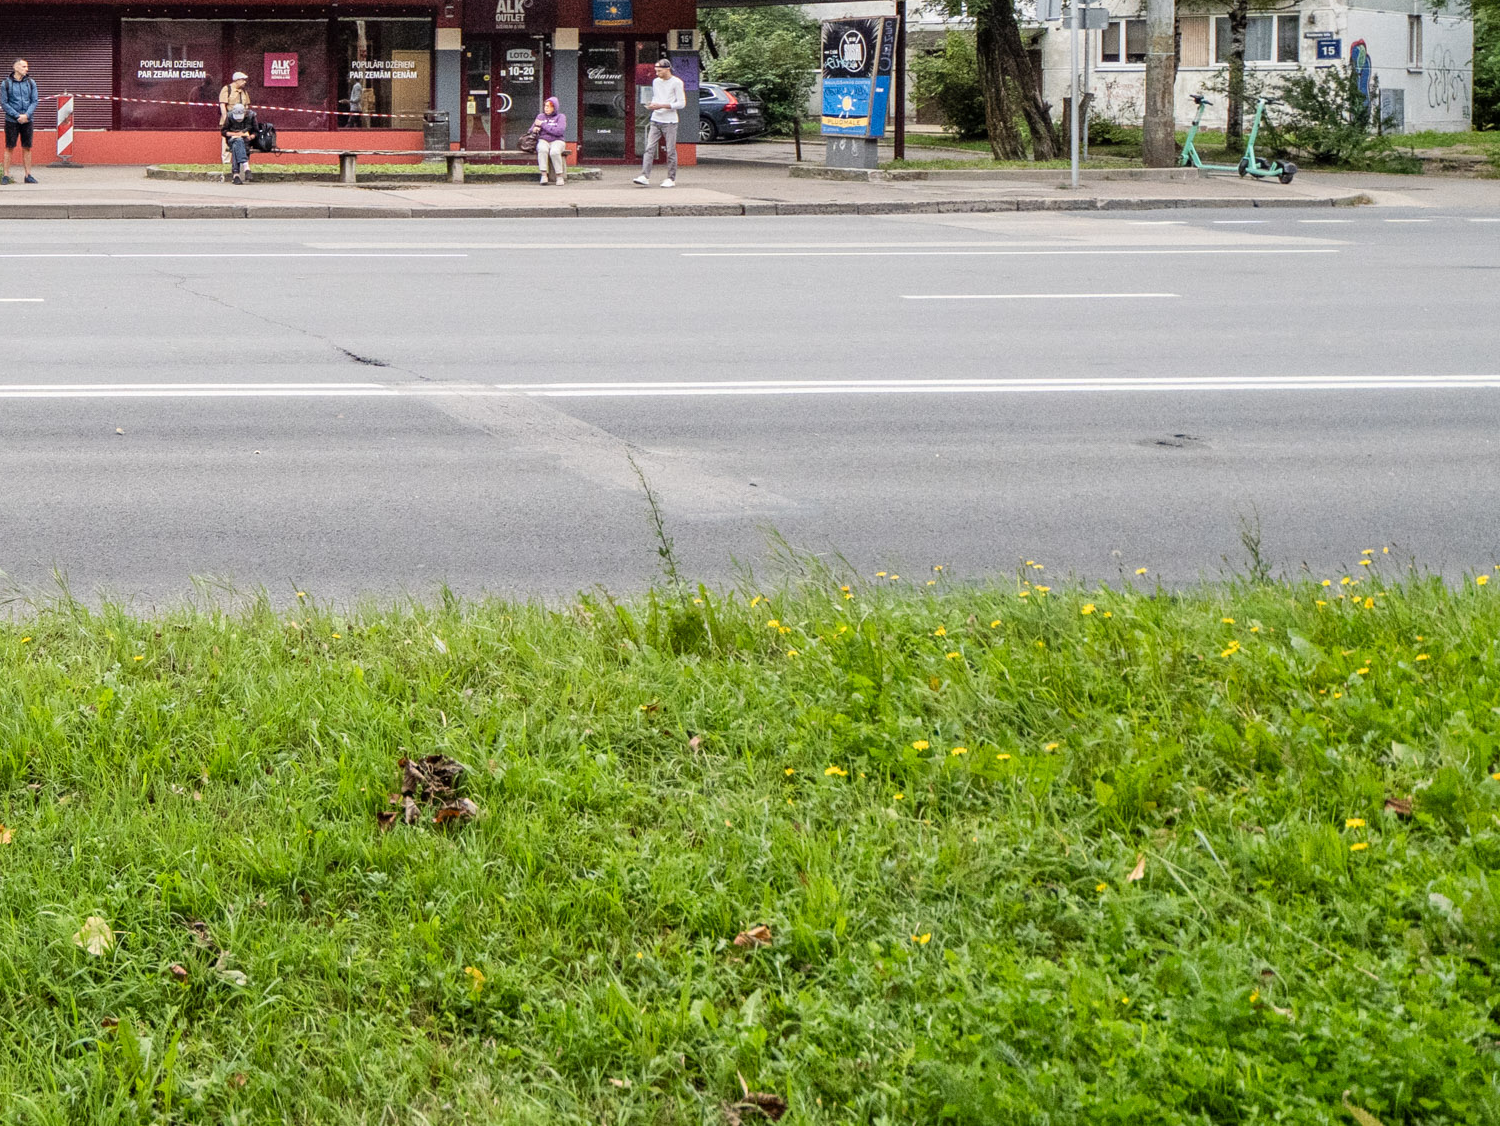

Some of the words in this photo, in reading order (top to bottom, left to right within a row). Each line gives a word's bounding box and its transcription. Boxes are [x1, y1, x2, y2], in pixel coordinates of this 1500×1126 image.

[495, 14, 525, 22] OUTLET
[1321, 46, 1336, 56] 15
[140, 59, 172, 68] POPULĀRI
[174, 59, 204, 68] DZĒRIENI
[352, 60, 384, 69] POPULĀRI
[385, 60, 415, 69] DZĒRIENI
[138, 71, 152, 79] PAR
[153, 69, 179, 79] ZEMĀM
[181, 70, 206, 79] CENĀM
[349, 71, 363, 79] PAR
[365, 70, 391, 79] ZEMĀM
[392, 70, 417, 79] CENĀM
[508, 66, 535, 76] 10-20
[587, 67, 623, 79] Charme
